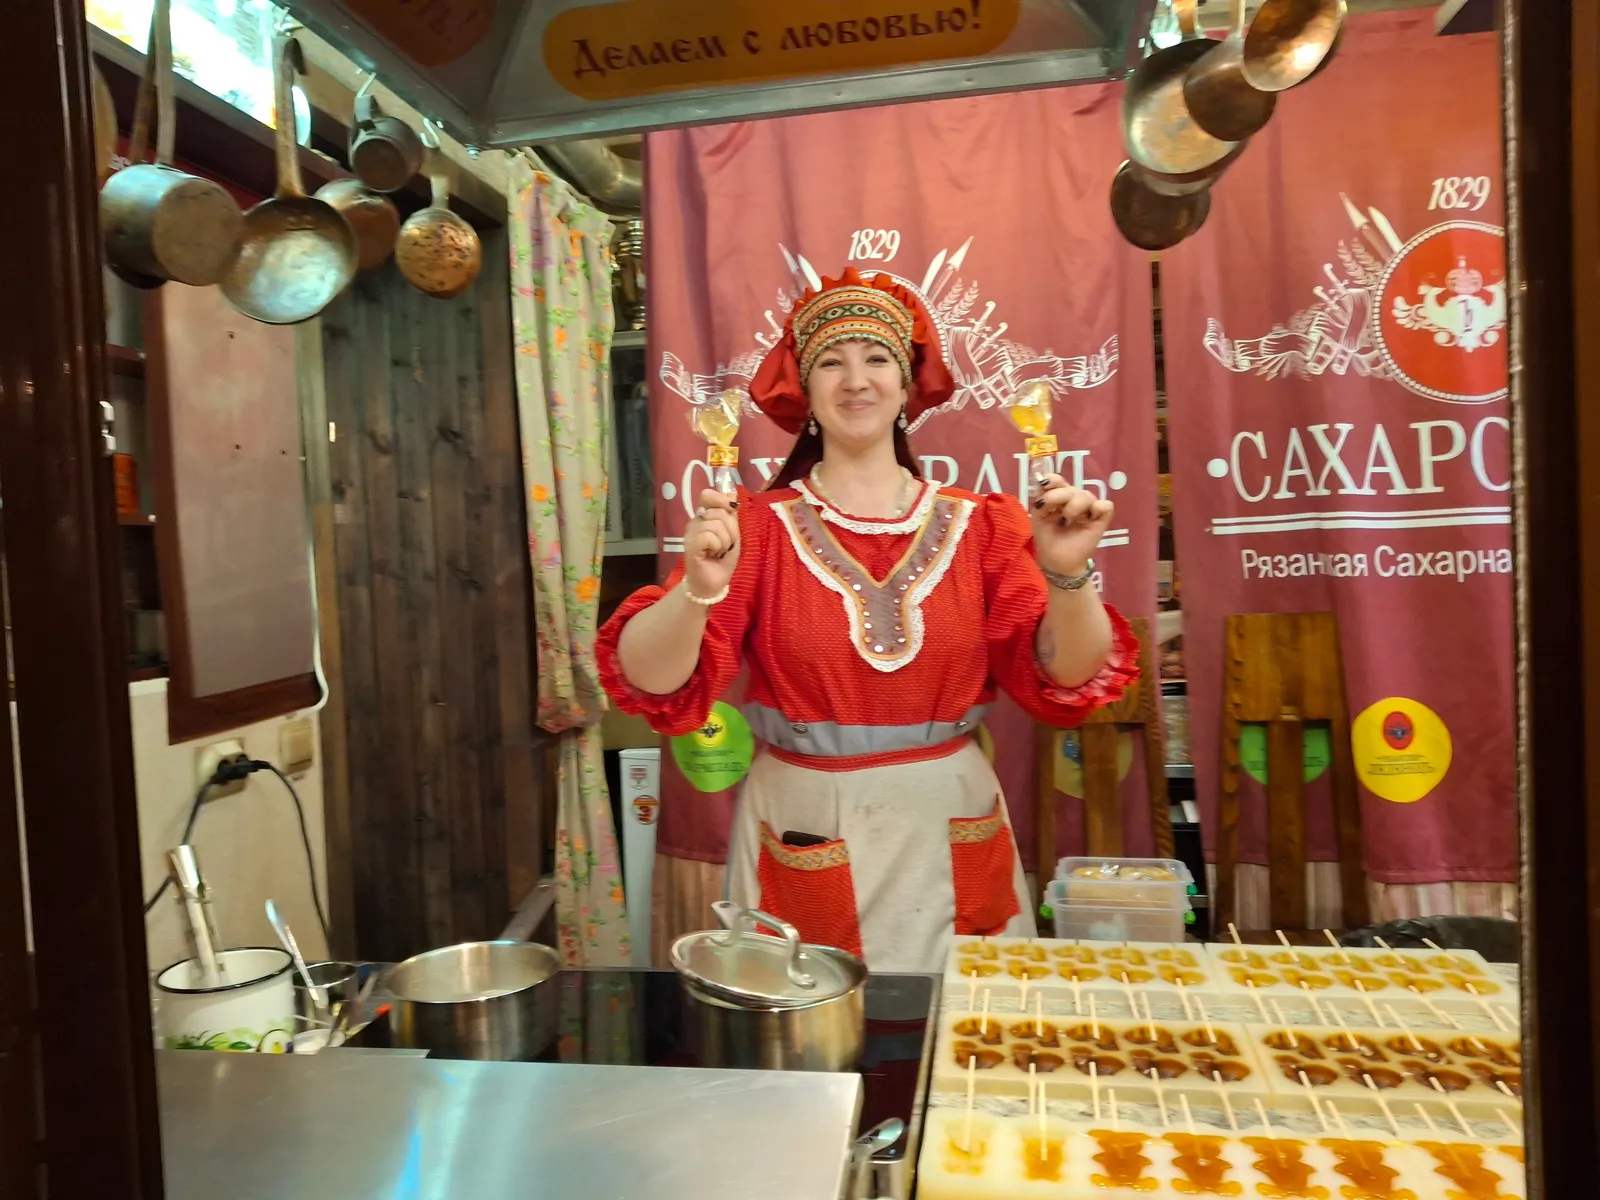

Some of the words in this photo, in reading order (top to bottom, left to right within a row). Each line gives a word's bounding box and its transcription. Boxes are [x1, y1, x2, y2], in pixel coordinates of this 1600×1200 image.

[572, 34, 728, 80] Делаем
[1427, 175, 1491, 211] 1829
[847, 228, 901, 263] 1829
